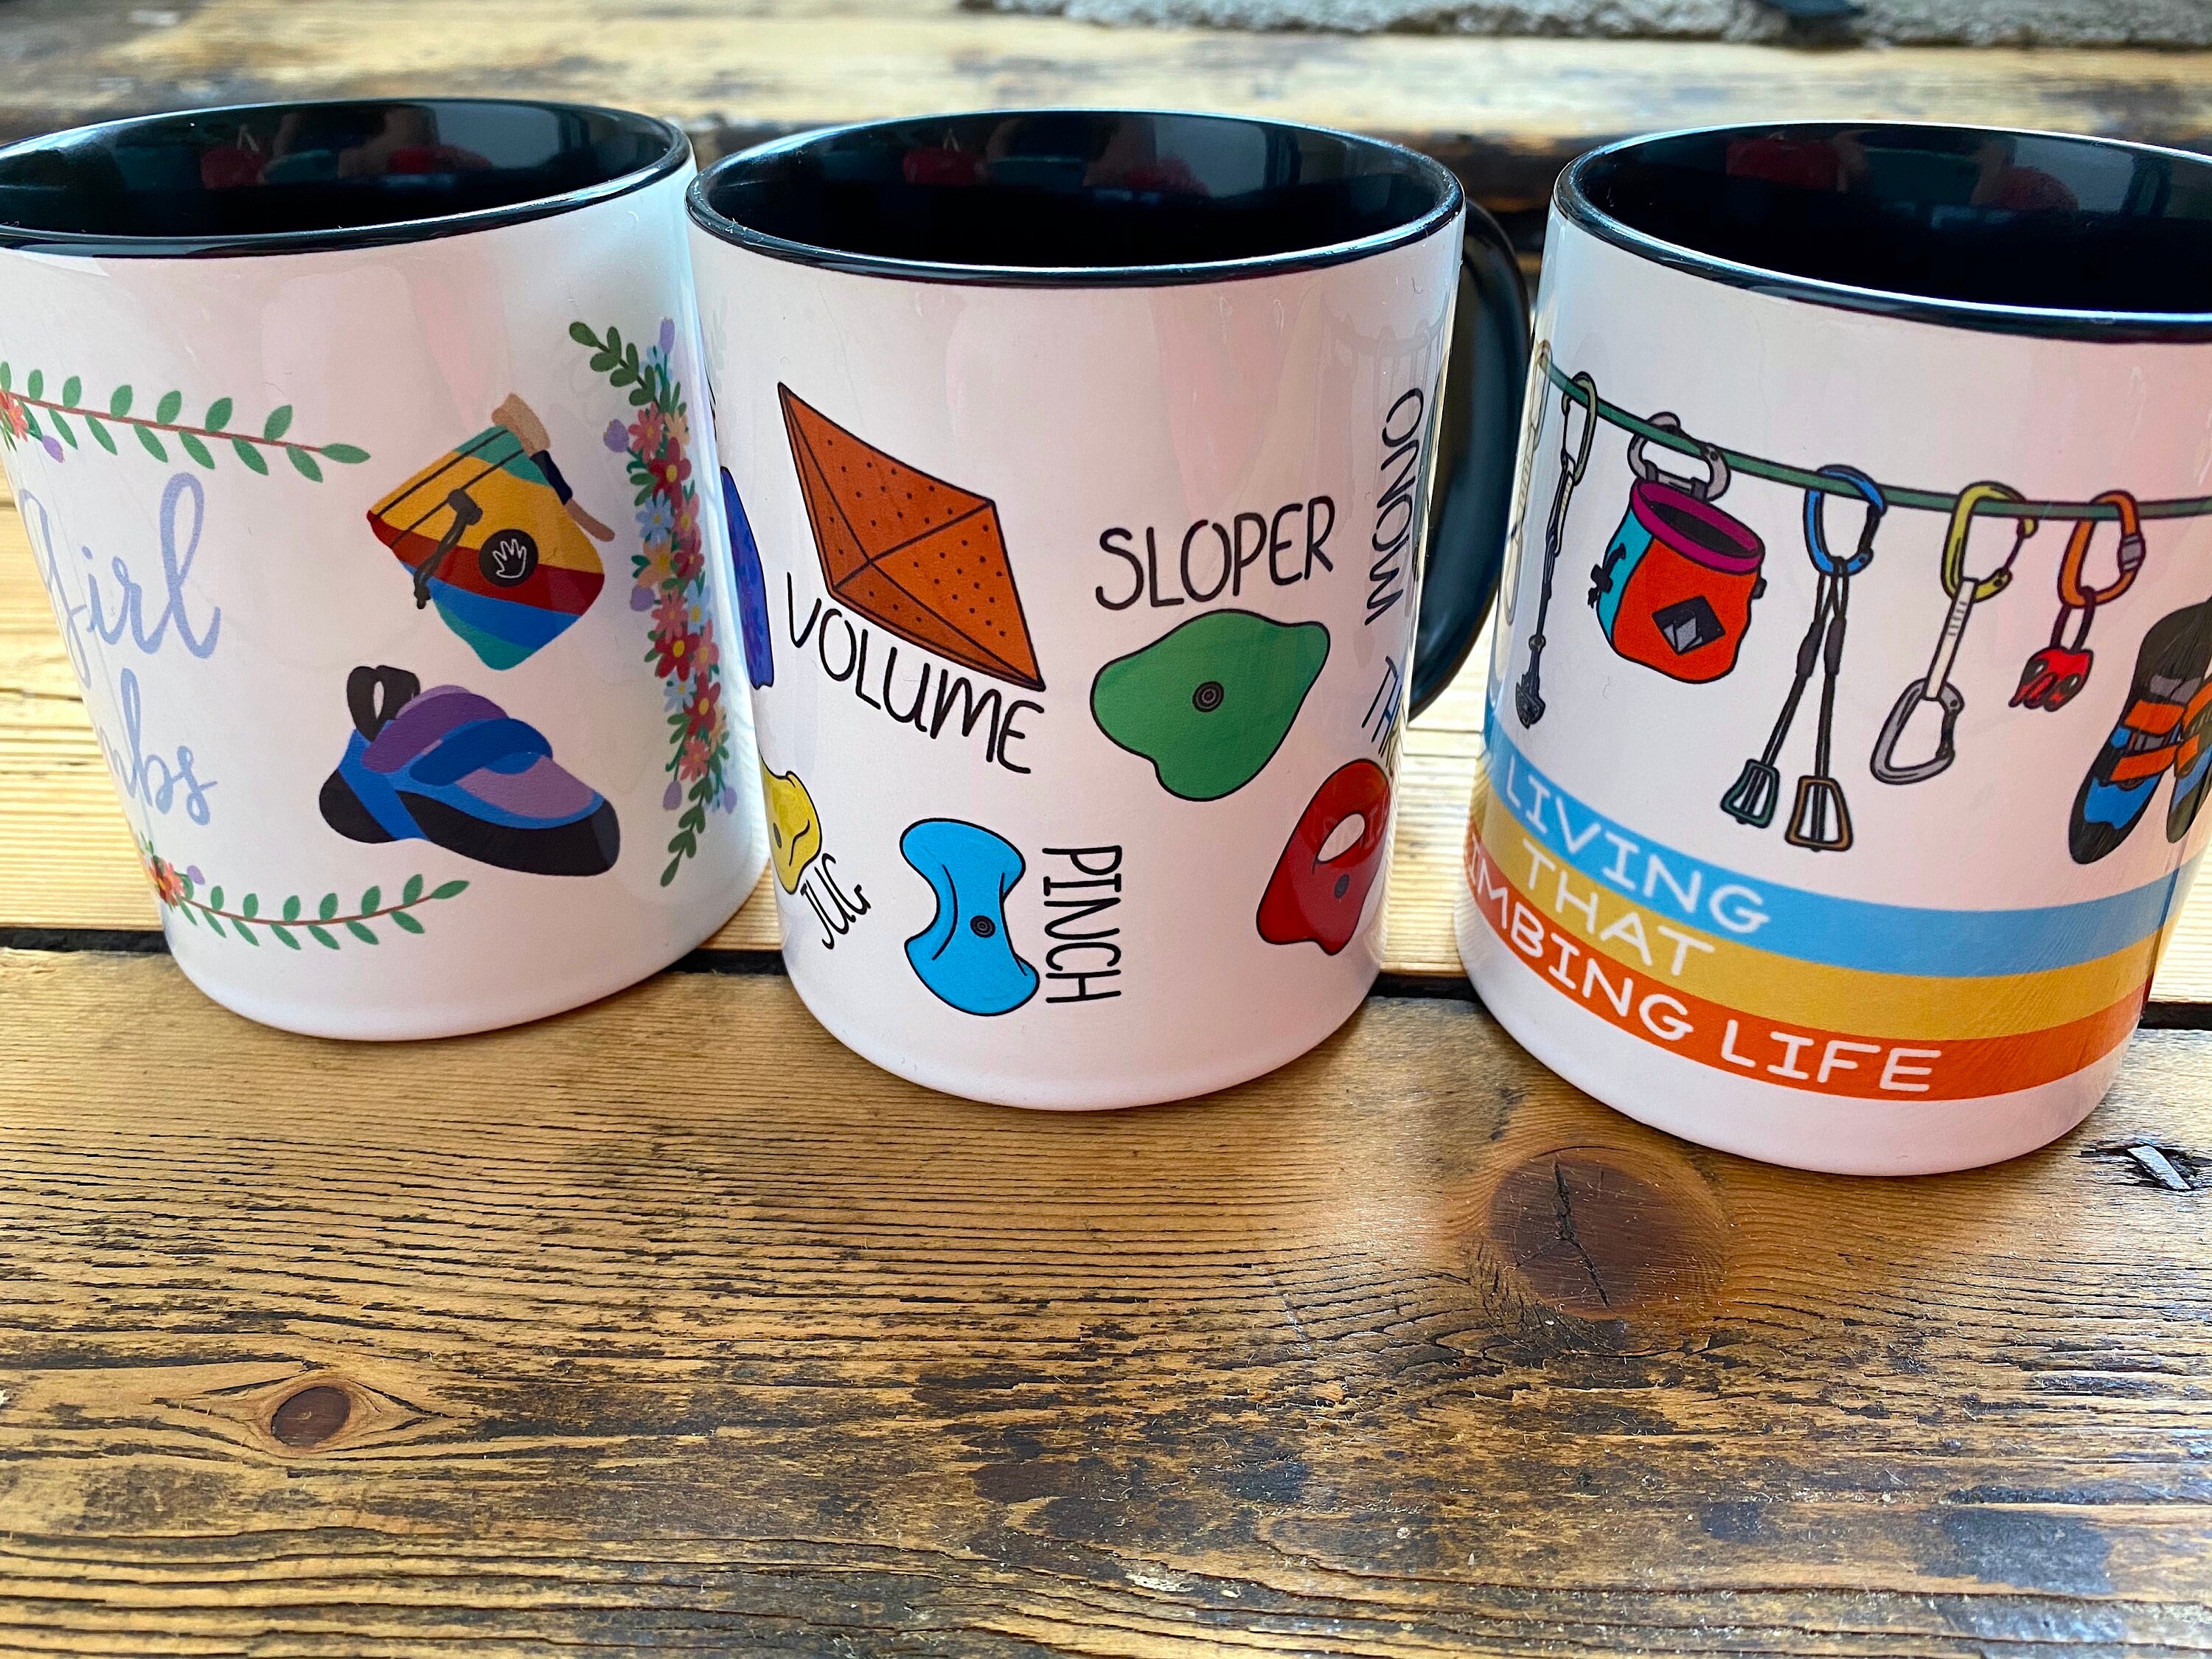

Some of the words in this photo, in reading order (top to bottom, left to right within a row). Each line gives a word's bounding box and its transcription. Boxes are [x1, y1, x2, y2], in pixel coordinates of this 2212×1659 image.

[1096, 495, 1335, 611] SLOPER
[1364, 388, 1425, 625] MONO
[786, 572, 1045, 774] VOLUME
[800, 852, 872, 950] JUG
[1505, 754, 1770, 934] LIVING
[1522, 838, 1715, 976] THAT
[1042, 845, 1122, 1004] PINCH
[1720, 1019, 1942, 1093] LIFE
